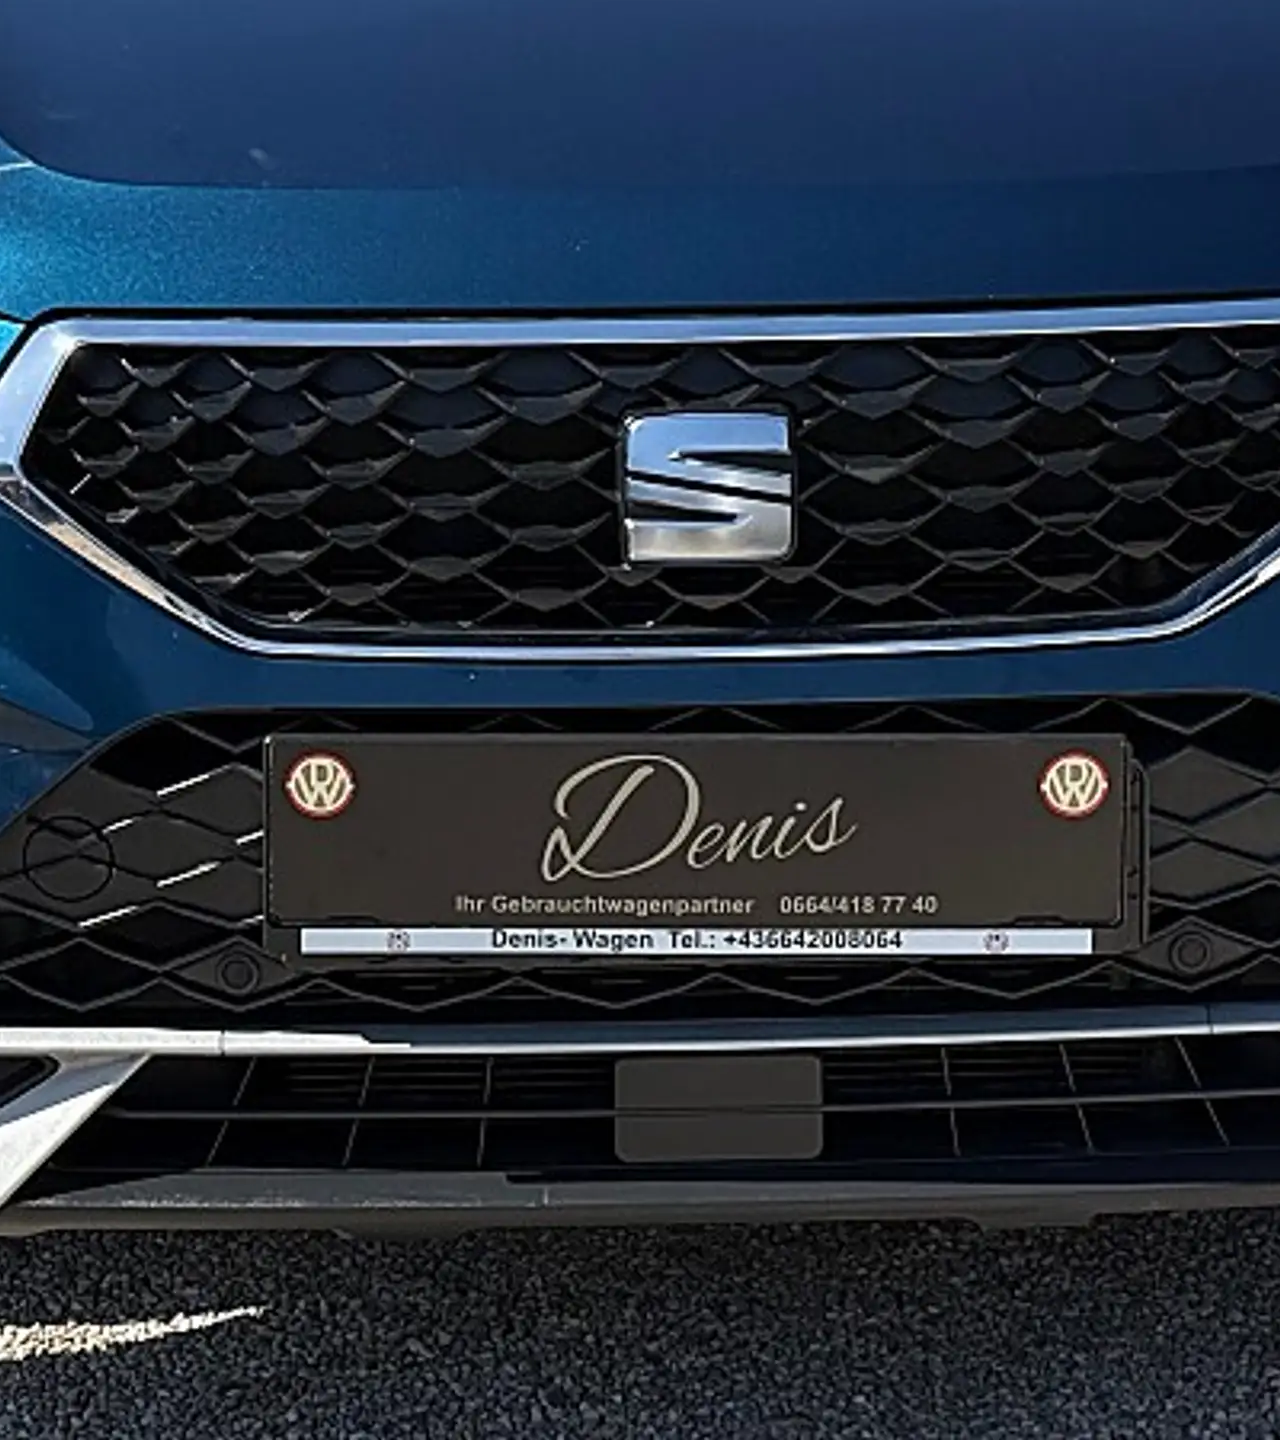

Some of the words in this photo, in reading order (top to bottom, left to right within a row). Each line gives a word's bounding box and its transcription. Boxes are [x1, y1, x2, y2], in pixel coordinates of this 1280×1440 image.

[540, 754, 858, 881] Denis
[455, 894, 486, 914] Ihr
[491, 894, 754, 918] Gebrauchtwagenpartner
[779, 894, 875, 914] 0664/418
[881, 894, 907, 914] 77
[911, 894, 939, 914] 40
[572, 930, 654, 952] Wagen
[669, 930, 716, 949] Tel.:
